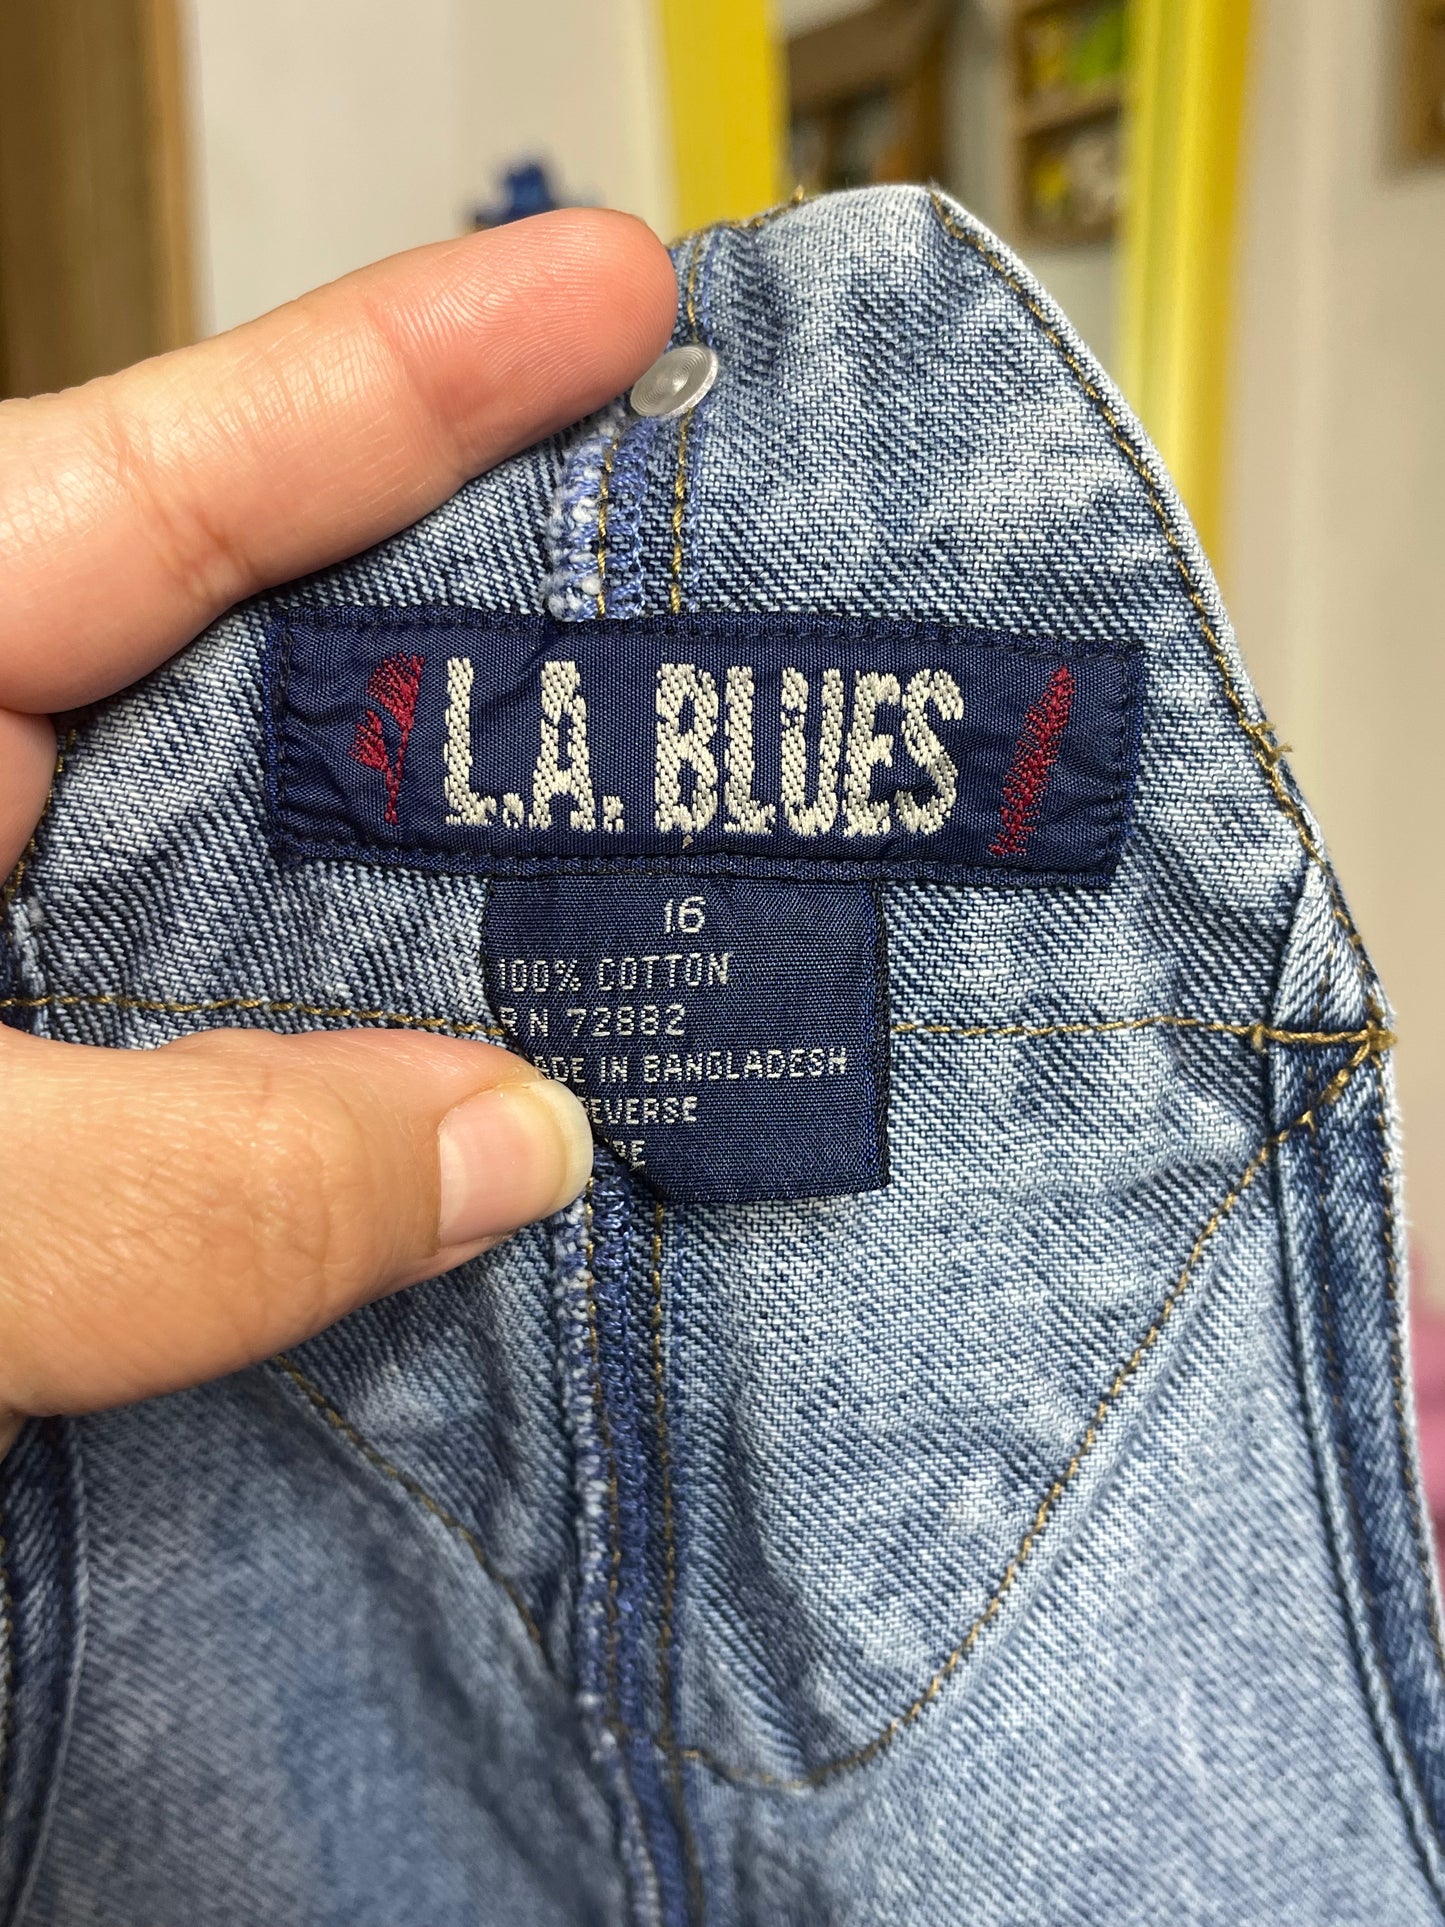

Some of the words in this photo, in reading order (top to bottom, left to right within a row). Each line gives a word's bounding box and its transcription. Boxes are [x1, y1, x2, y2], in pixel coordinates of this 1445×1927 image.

[443, 658, 624, 831] L.A.
[655, 662, 964, 837] BLUES
[664, 896, 706, 933] 16
[499, 959, 581, 992] 100%
[599, 952, 732, 991] COTTON
[566, 1004, 685, 1037] 72882
[533, 1055, 586, 1083] ADE
[601, 1055, 629, 1083] IN
[644, 1047, 848, 1083] BANGLADESH
